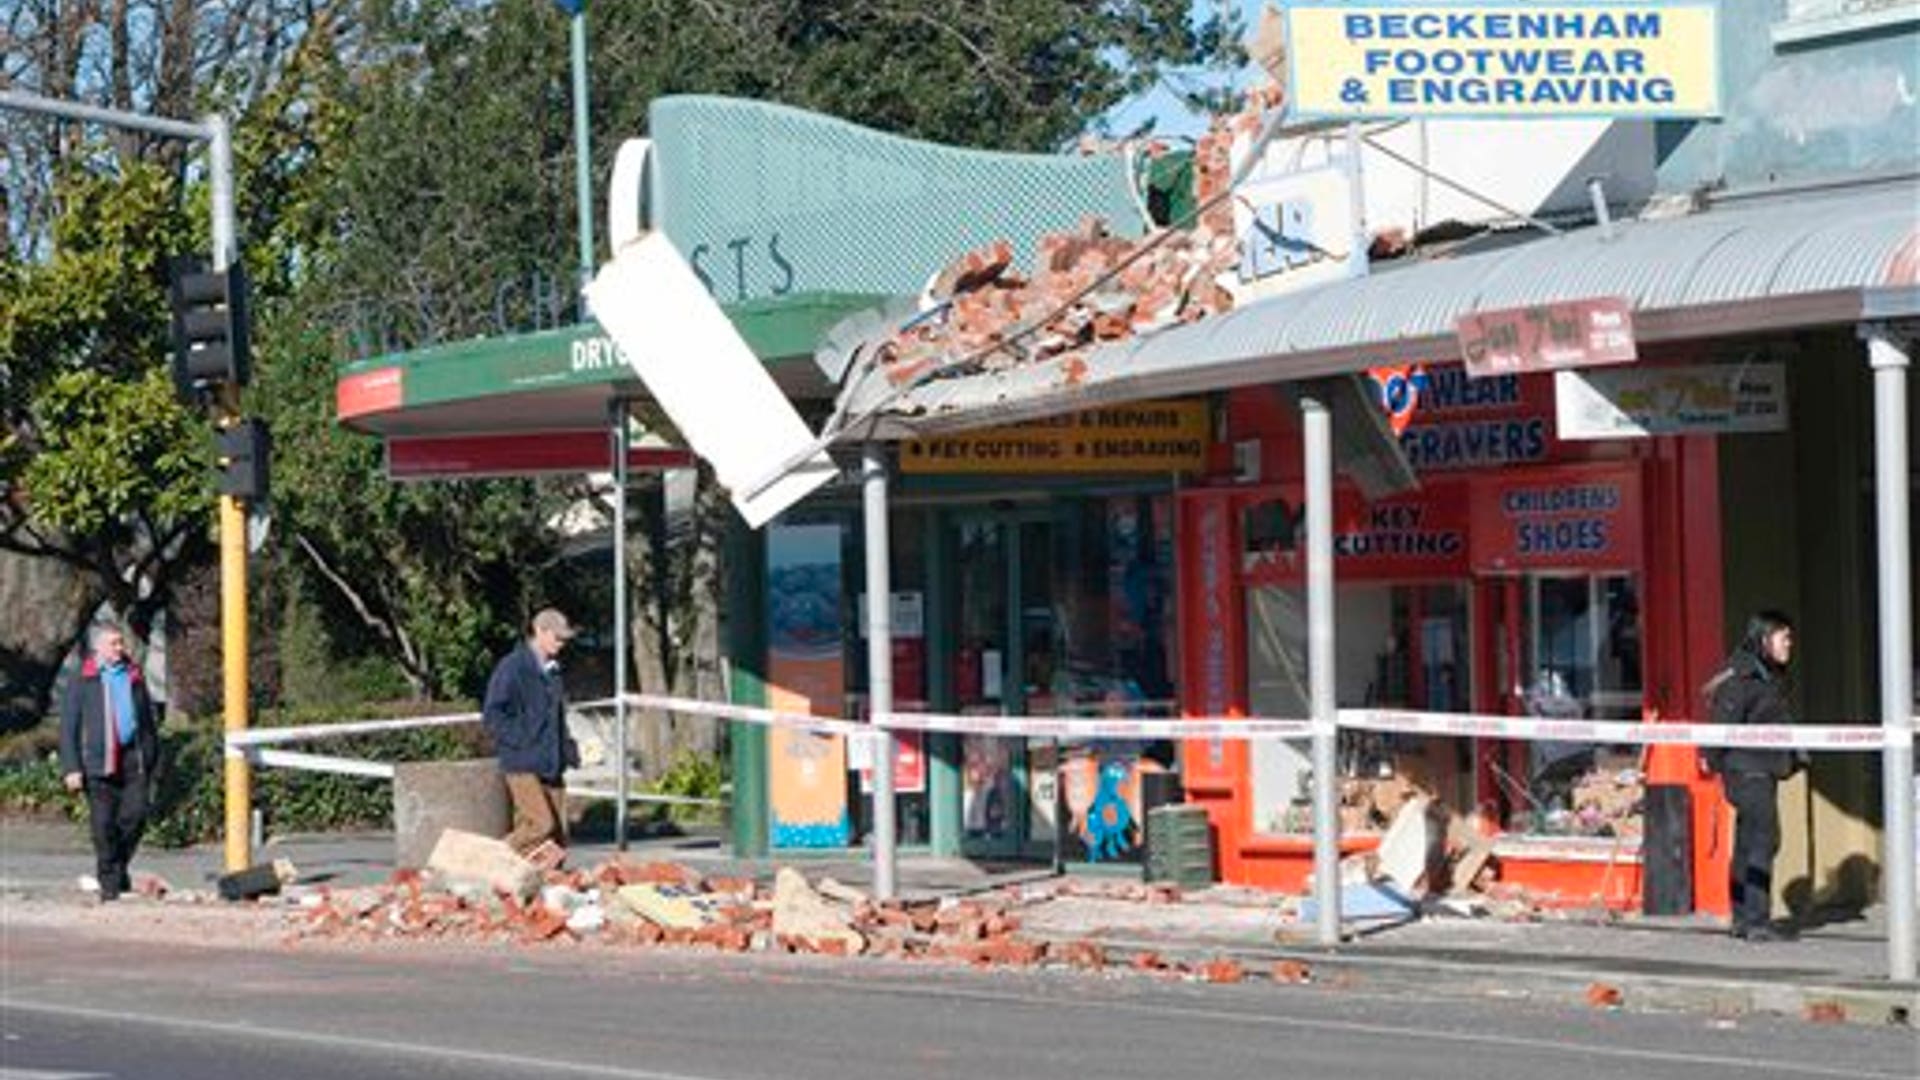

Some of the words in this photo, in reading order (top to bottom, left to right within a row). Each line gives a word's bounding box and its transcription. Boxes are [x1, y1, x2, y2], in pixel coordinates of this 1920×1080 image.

[1344, 14, 1662, 39] BECKENHAM
[1364, 50, 1645, 75] FOOTWEAR
[1339, 79, 1367, 104] &
[1387, 79, 1676, 104] ENGRAVING
[1097, 408, 1180, 427] REPAIRS
[928, 440, 969, 459] KEY
[974, 440, 1060, 459] CUTTING
[1093, 439, 1200, 459] ENGRAVING
[1504, 485, 1620, 512] CHILDRENS
[1371, 506, 1423, 527] KEY
[1334, 532, 1463, 555] CUTTING
[1517, 520, 1608, 553] SHOES
